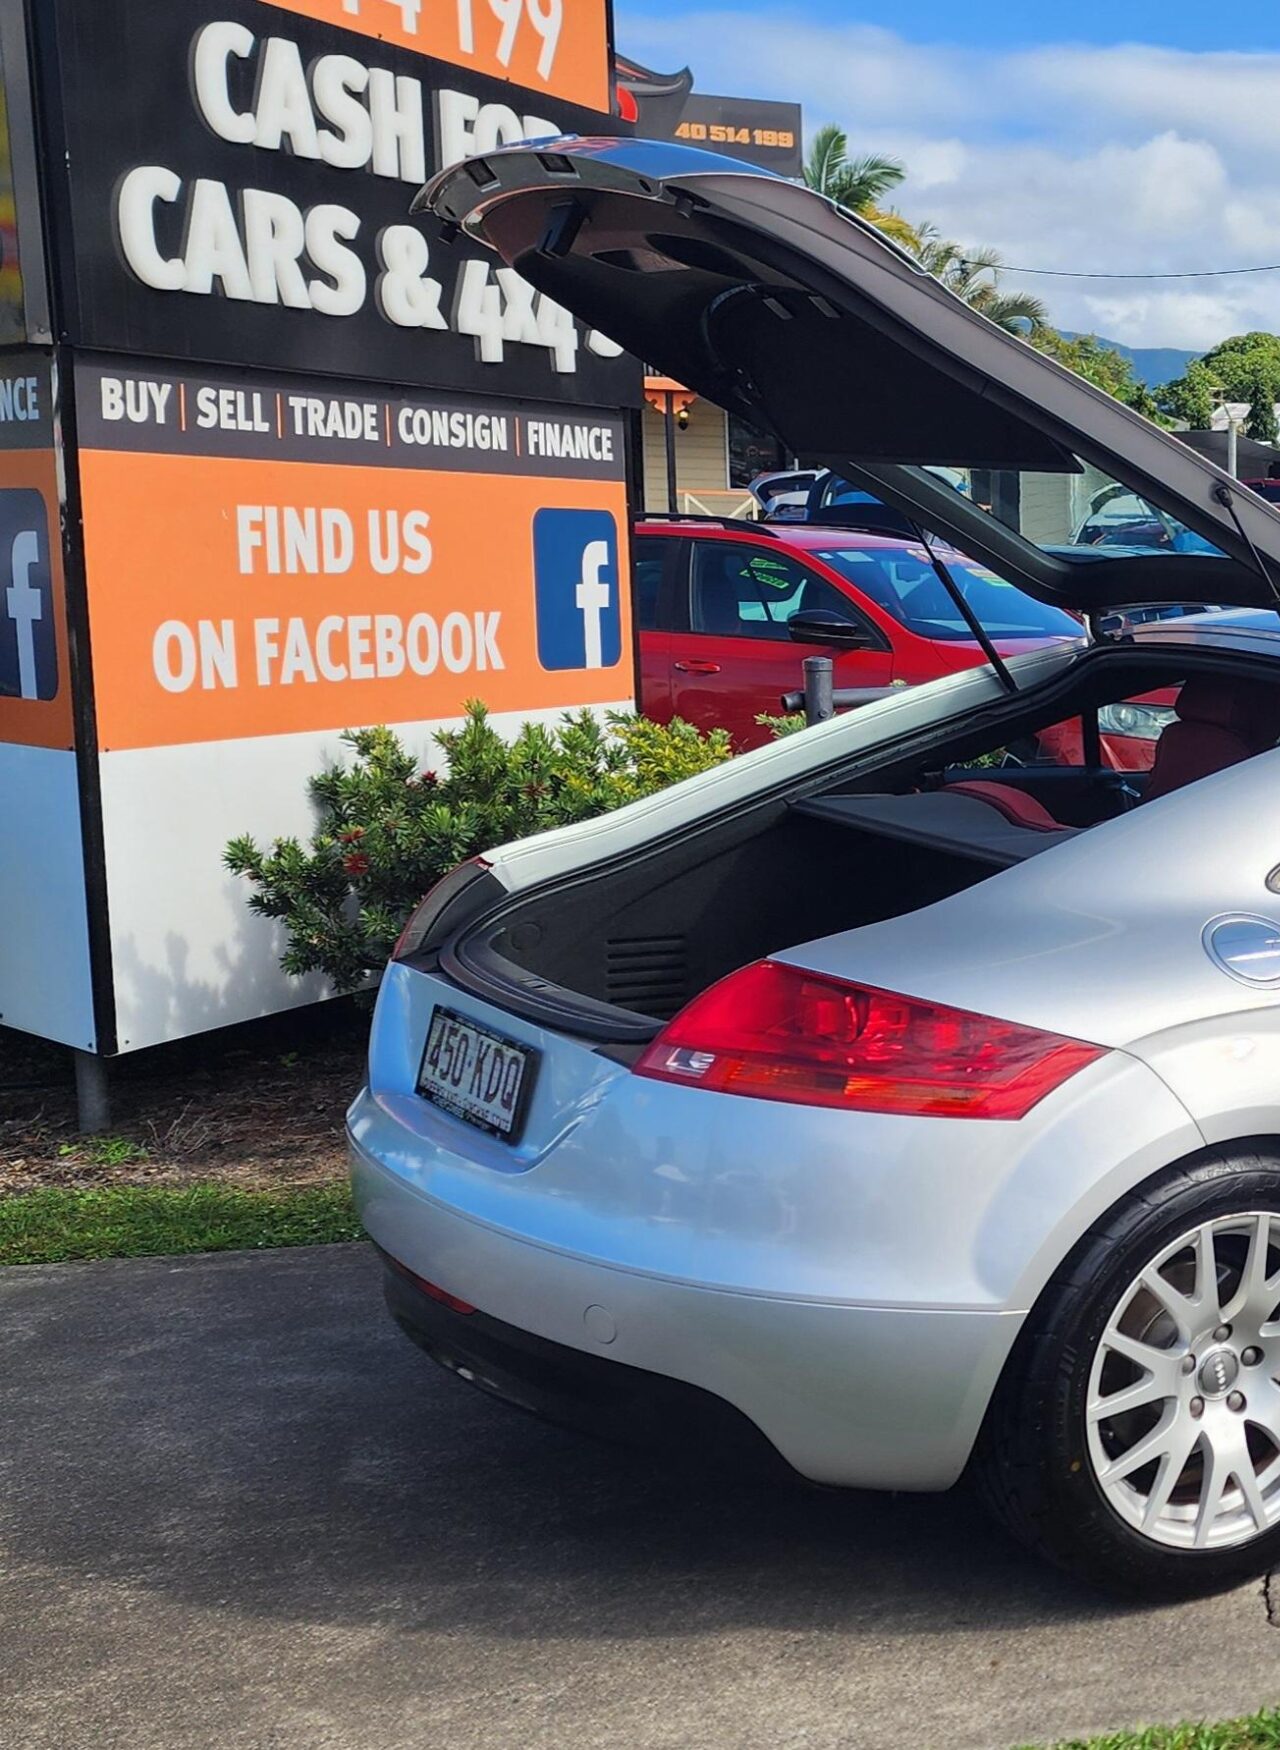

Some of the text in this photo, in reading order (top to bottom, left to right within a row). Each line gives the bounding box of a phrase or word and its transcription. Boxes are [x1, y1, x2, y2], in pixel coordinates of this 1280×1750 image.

[195, 21, 426, 184] CASH
[675, 122, 794, 148] 40 514 199
[119, 166, 367, 316] CARS
[382, 225, 449, 330] &
[101, 377, 614, 461] BUY SELL TRADE CONSIGN FINANCE
[237, 505, 433, 575] FIND US
[153, 611, 505, 693] ON FACEBOOK
